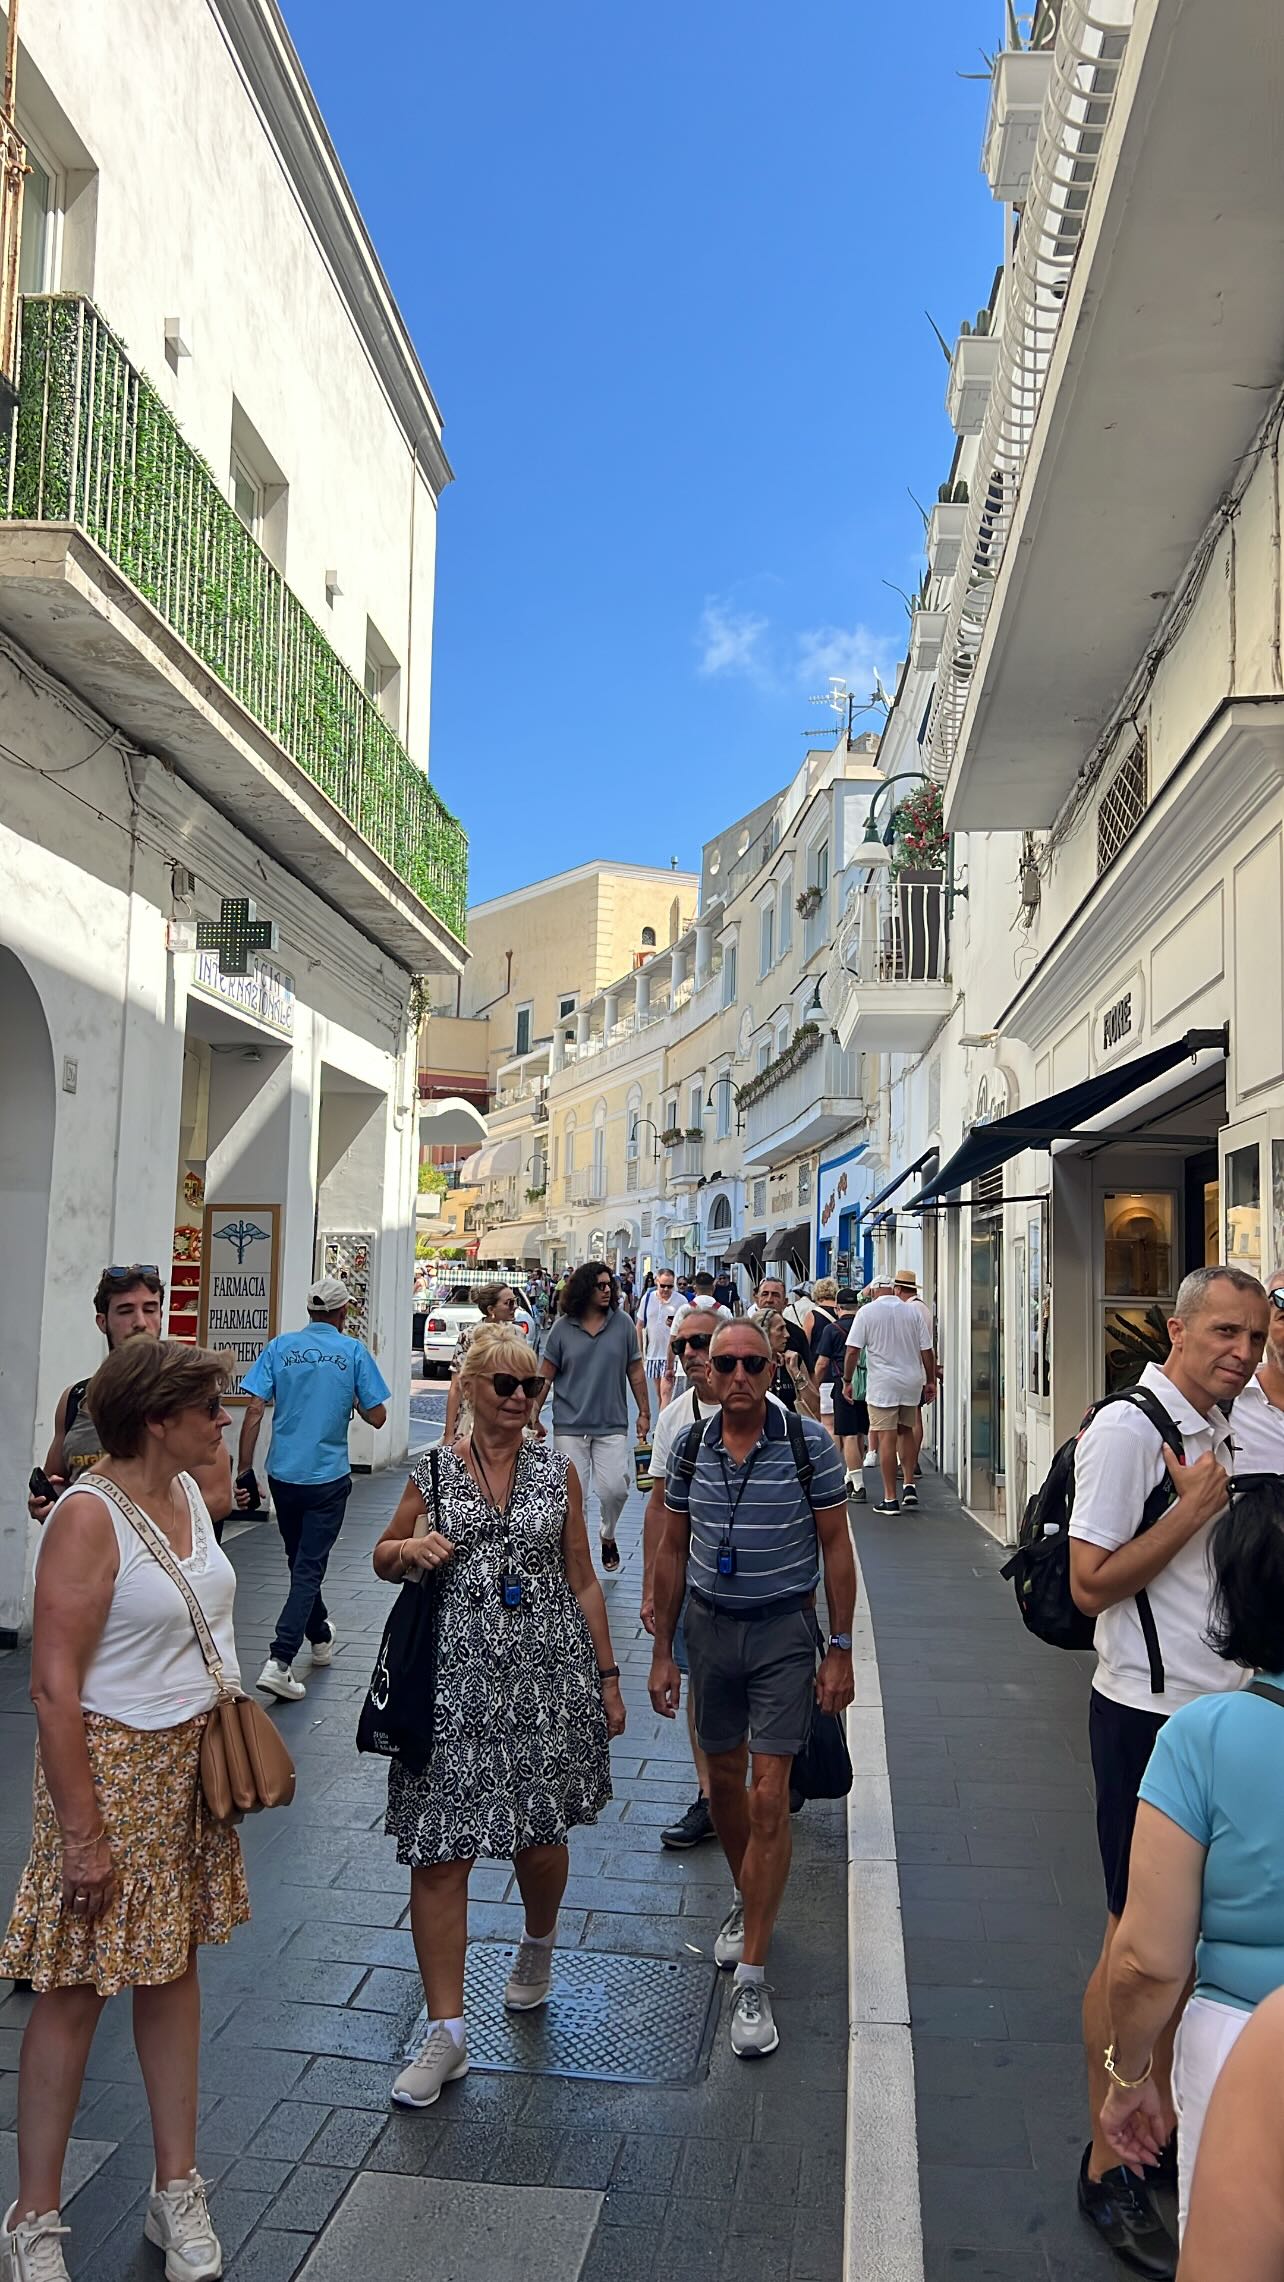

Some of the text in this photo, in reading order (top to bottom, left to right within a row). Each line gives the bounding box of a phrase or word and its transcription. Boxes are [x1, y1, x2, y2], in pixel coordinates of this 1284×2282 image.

[213, 1276, 266, 1297] FARMACIA
[209, 1309, 268, 1330] PHARMACIE
[150, 1541, 205, 1635] LAURENT DAVID
